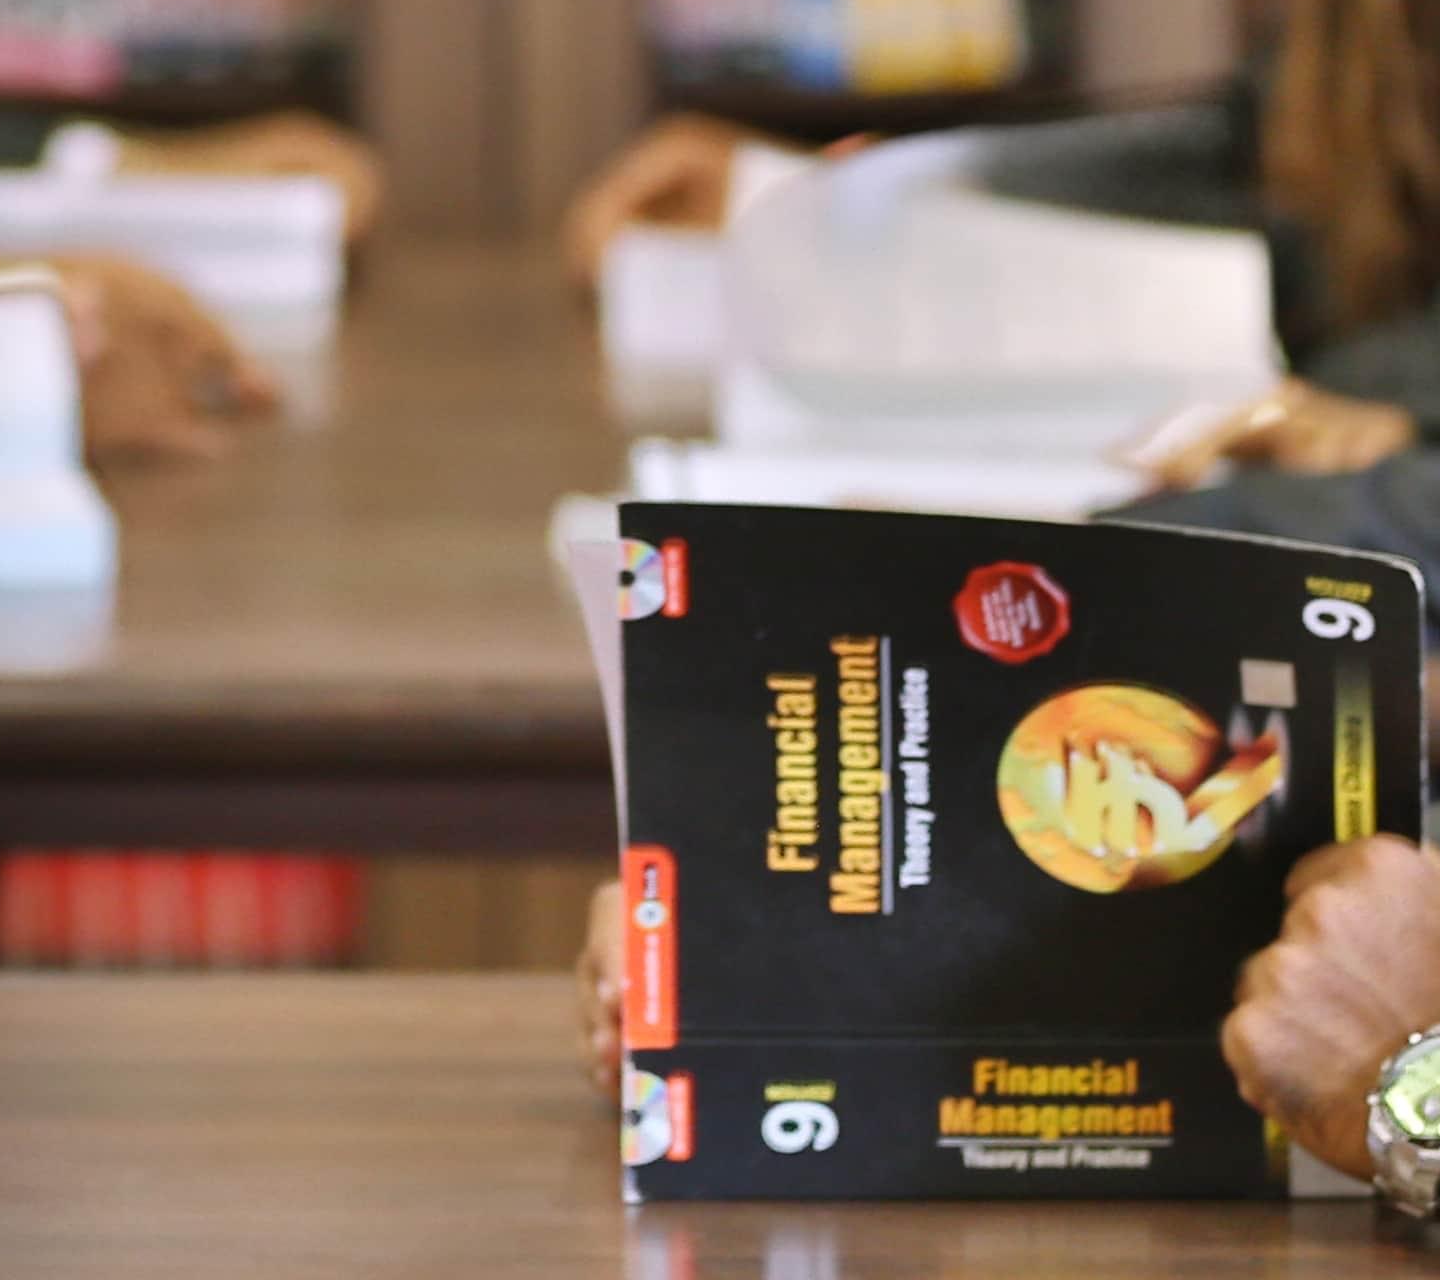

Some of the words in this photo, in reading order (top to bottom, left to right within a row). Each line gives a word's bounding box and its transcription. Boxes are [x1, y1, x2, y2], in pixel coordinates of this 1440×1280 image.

[1302, 597, 1375, 641] 9
[901, 667, 930, 758] Practice
[766, 675, 820, 873] Financial
[828, 636, 887, 915] Management
[901, 760, 930, 805] and
[899, 806, 936, 888] Theory
[972, 1058, 1138, 1096] Financial
[761, 1100, 840, 1153] 9
[938, 1096, 1173, 1142] Management
